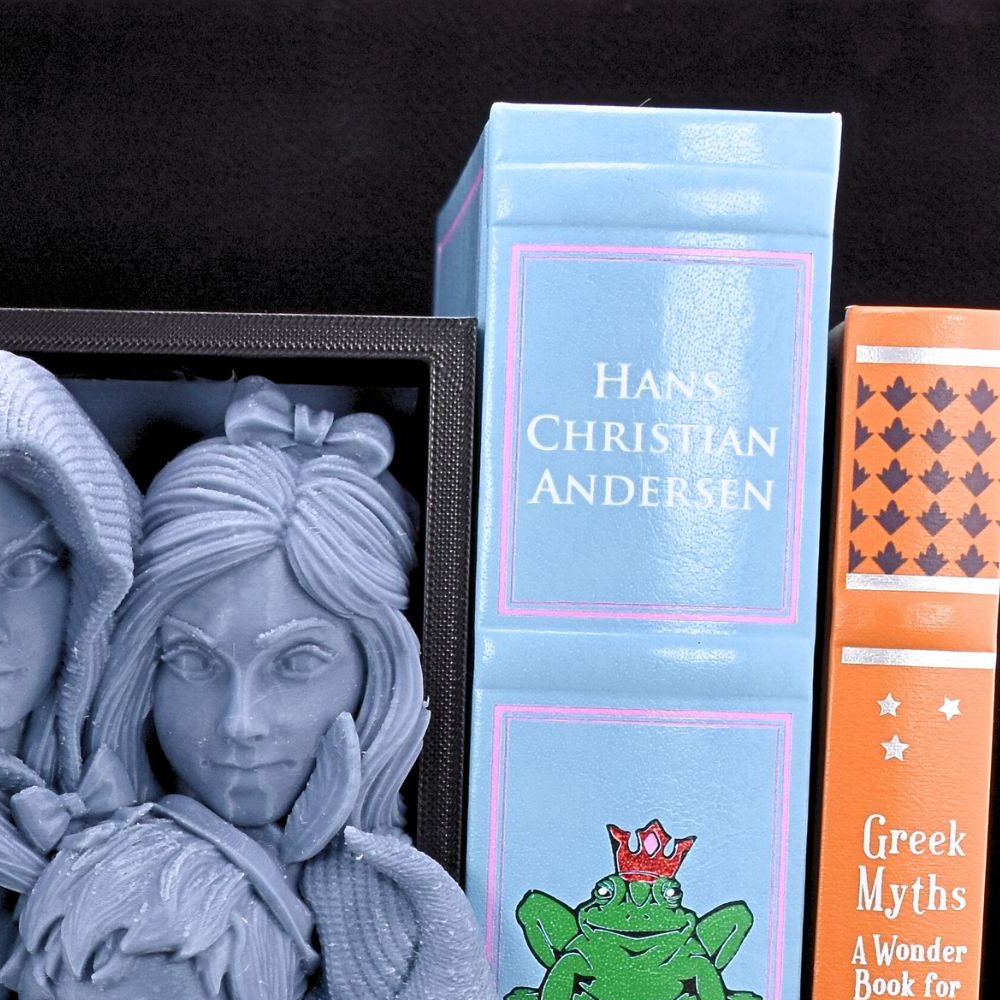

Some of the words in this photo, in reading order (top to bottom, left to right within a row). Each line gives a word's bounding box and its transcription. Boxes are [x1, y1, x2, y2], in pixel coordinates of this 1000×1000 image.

[593, 361, 722, 401] HANS
[526, 413, 780, 457] CHRISTIAN
[526, 468, 774, 511] ANDERSEN
[863, 813, 966, 860] Greek
[856, 865, 967, 920] Myths
[851, 935, 868, 965] A
[872, 933, 968, 966] Wonder
[854, 968, 915, 1000] Book
[923, 971, 962, 999] for
